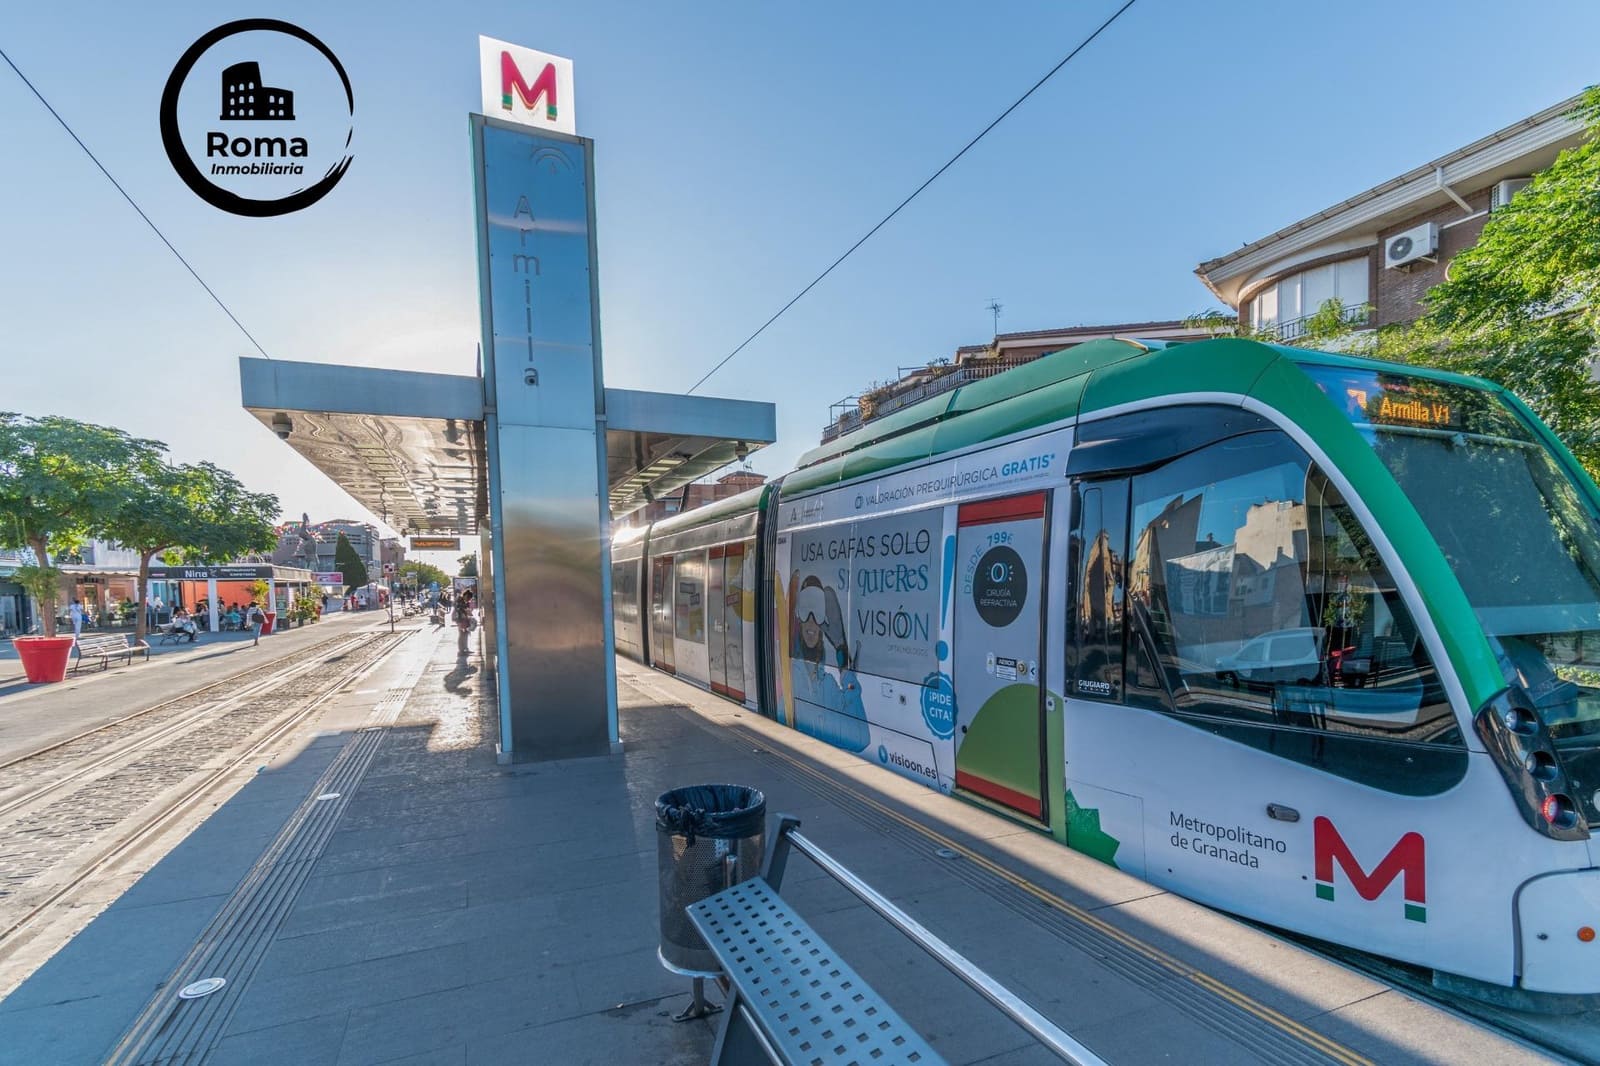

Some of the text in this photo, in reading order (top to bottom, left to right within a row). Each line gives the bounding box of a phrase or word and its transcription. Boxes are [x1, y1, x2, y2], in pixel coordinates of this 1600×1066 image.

[501, 50, 558, 122] M
[513, 195, 542, 387] Armilla
[1379, 396, 1430, 423] Armilla
[865, 485, 914, 506] VALORACIÓN
[916, 466, 999, 496] PREQUIRÚRGICA
[801, 528, 930, 563] USA GAFAS SOLO
[980, 598, 1018, 607] REFRACTIVA
[929, 691, 952, 706] ¡PIDE
[1078, 679, 1110, 690] GIUGIARO
[929, 707, 953, 721] CITA!
[889, 751, 937, 780] visioon.es
[1169, 810, 1287, 854] Metropolitano
[1170, 832, 1259, 869] de Granada
[1313, 815, 1427, 924] M
